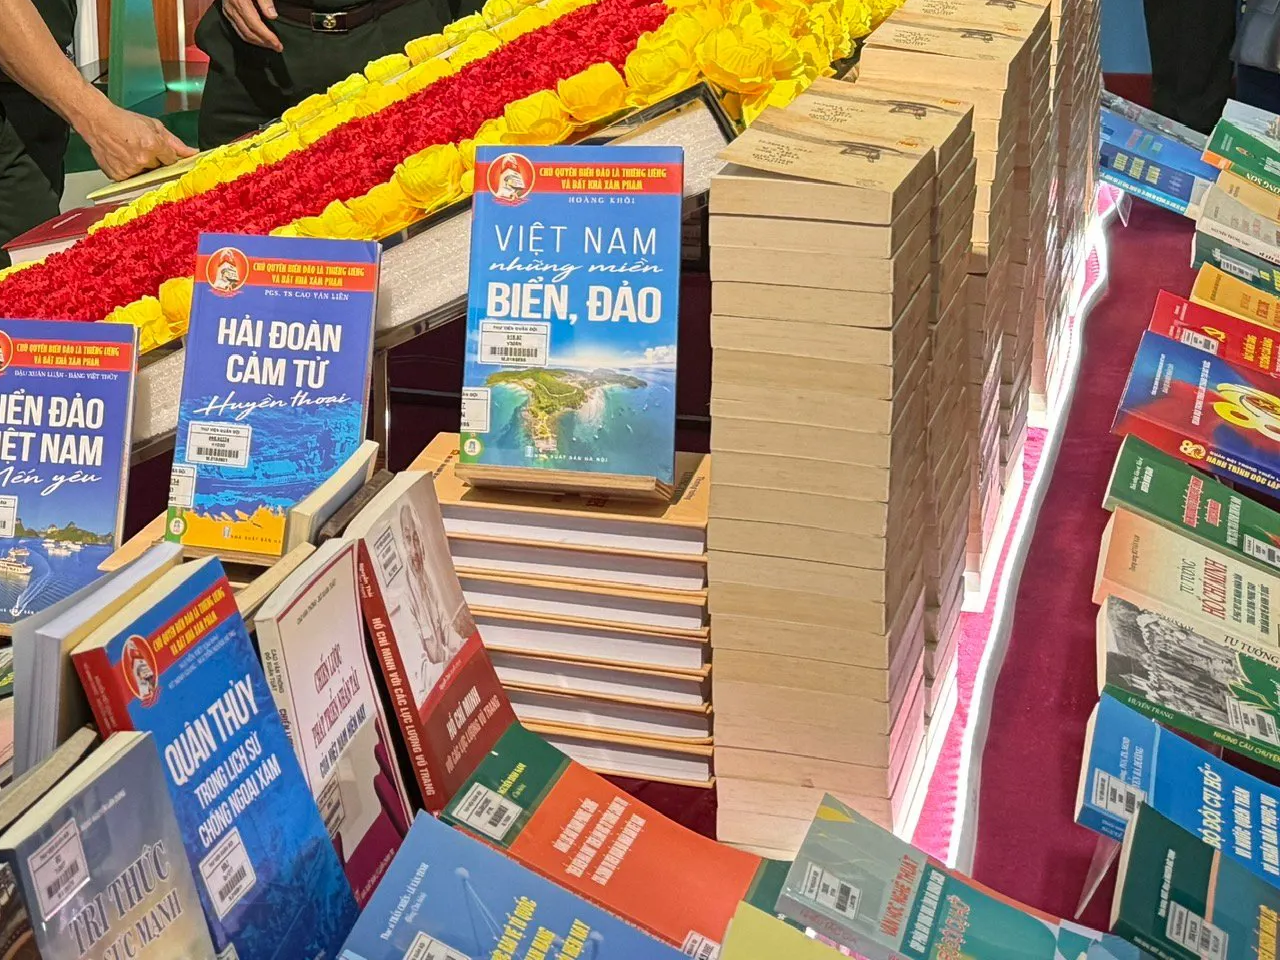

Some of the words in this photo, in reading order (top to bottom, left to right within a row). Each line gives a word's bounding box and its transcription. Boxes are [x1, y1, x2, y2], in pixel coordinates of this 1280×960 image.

[540, 167, 553, 177] CHỦ
[554, 167, 577, 178] QUYỀN
[578, 167, 594, 177] BIỂN
[595, 167, 610, 177] ĐẢO
[612, 168, 620, 177] LÀ
[622, 168, 646, 178] THIÊNG
[647, 168, 667, 178] LIÊNG
[561, 178, 571, 189] VÀ
[572, 179, 586, 189] BẤT
[588, 179, 602, 190] KHẢ
[604, 179, 620, 190] XÂM
[621, 180, 643, 190] PHẠM
[495, 222, 568, 256] VIỆT
[584, 226, 657, 255] NAM
[489, 257, 583, 282] những
[588, 258, 663, 274] miền
[486, 276, 577, 325] BIỂN,
[586, 280, 662, 324] ĐẢO
[217, 313, 263, 348] HẢI
[269, 319, 342, 353] ĐOÀN
[226, 353, 286, 387] CẢM
[293, 356, 330, 389] TỬ
[48, 391, 105, 430] ĐẢO
[193, 390, 288, 421] Huyền
[290, 389, 352, 408] thoại
[40, 434, 104, 467] NAM
[1205, 453, 1227, 468] HÀNH
[1226, 462, 1251, 478] TRÌNH
[1249, 471, 1268, 486] ĐỘC
[40, 470, 103, 496] yêu
[1179, 557, 1198, 582] TƯỞNG
[1206, 556, 1228, 587] MINH
[1180, 581, 1196, 594] TƯ
[1202, 579, 1226, 602] CHÍ
[1196, 595, 1226, 619] HỒ
[372, 617, 381, 630] HỒ
[376, 629, 387, 644] CHÍ
[1223, 633, 1241, 648] TƯ
[1241, 641, 1280, 664] TƯỞNG
[314, 653, 330, 694] CHIẾN
[328, 643, 342, 676] LƯỢC
[381, 645, 396, 671] MINH
[389, 670, 402, 688] VỚI
[312, 711, 327, 749] PHÁT
[323, 688, 340, 732] TRIỂN
[337, 678, 352, 713] NHÂN
[349, 665, 360, 696] TÀI
[394, 687, 408, 707] CÁC
[399, 705, 414, 728] LỰC
[446, 711, 458, 741] HỒ
[453, 700, 467, 730] CHÍ
[462, 685, 481, 718] MINH
[1151, 704, 1173, 720] TRANG
[164, 719, 219, 787] QUÂN
[207, 673, 261, 742] THỦY
[407, 727, 422, 753] LƯỢNG
[194, 765, 228, 811] TRONG
[226, 744, 249, 785] LỊCH
[245, 730, 262, 766] SỬ
[415, 753, 428, 767] VŨ
[419, 766, 436, 797] TRANG
[199, 800, 235, 849] CHỐNG
[229, 775, 260, 822] NGOẠI
[254, 752, 282, 798] XÂM
[1202, 787, 1225, 808] CỤ
[1232, 786, 1252, 807] THÂN
[1258, 793, 1279, 808] VỤ
[1202, 804, 1225, 830] ĐỘI
[1230, 805, 1255, 828] QUÊN
[1258, 805, 1280, 829] PHỤC
[1202, 826, 1225, 849] BỘ
[1230, 825, 1254, 850] NƯỚC
[1258, 825, 1280, 844] DÂN
[1232, 846, 1252, 859] VÌ
[1257, 841, 1280, 865] NHÂN
[1260, 862, 1280, 875] VÌ
[67, 892, 112, 959] TRI
[106, 841, 172, 922] THỨC
[511, 893, 540, 923] QUỐC
[501, 922, 523, 943] VỆ
[504, 910, 527, 932] TỔ
